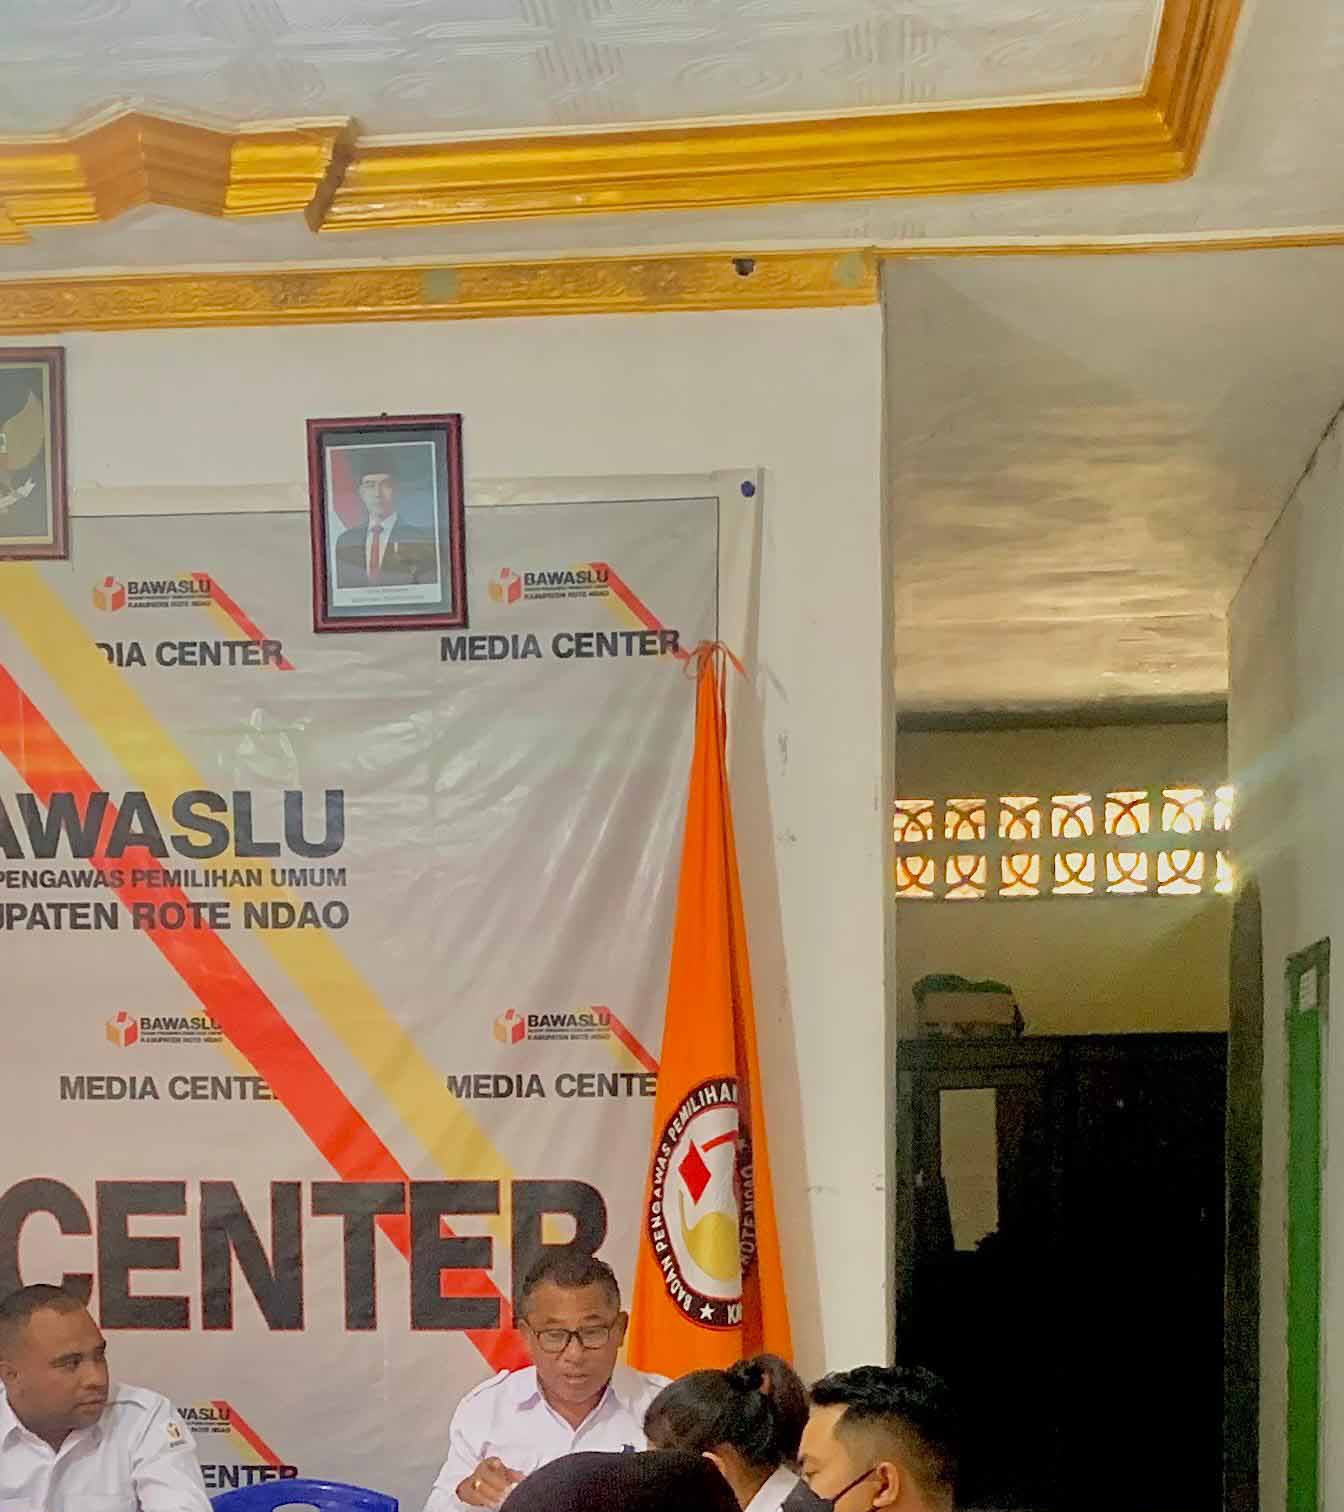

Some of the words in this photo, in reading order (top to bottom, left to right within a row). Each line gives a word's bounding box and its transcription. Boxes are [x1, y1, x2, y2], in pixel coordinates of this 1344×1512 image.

[128, 579, 212, 595] BAWASLU
[524, 570, 609, 586] BAWASLU
[95, 641, 146, 667] DIA
[155, 640, 283, 667] CENTER
[440, 633, 543, 662] MEDIA
[551, 629, 680, 659] CENTER
[131, 868, 264, 888] PEMILIHAN
[270, 867, 347, 888] UMUM
[132, 901, 232, 930] ROTE
[243, 900, 351, 930] NDAO
[528, 1014, 610, 1028] BAWASLU
[59, 1076, 160, 1100] MEDIA
[168, 1076, 279, 1100] CENTE
[447, 1074, 546, 1099] MEDIA
[555, 1073, 658, 1098] CENTE
[651, 1143, 672, 1252] PENGAWAS
[660, 1257, 693, 1312] BADAN
[177, 1407, 231, 1421] WASLU
[200, 1464, 298, 1488] ENTER
